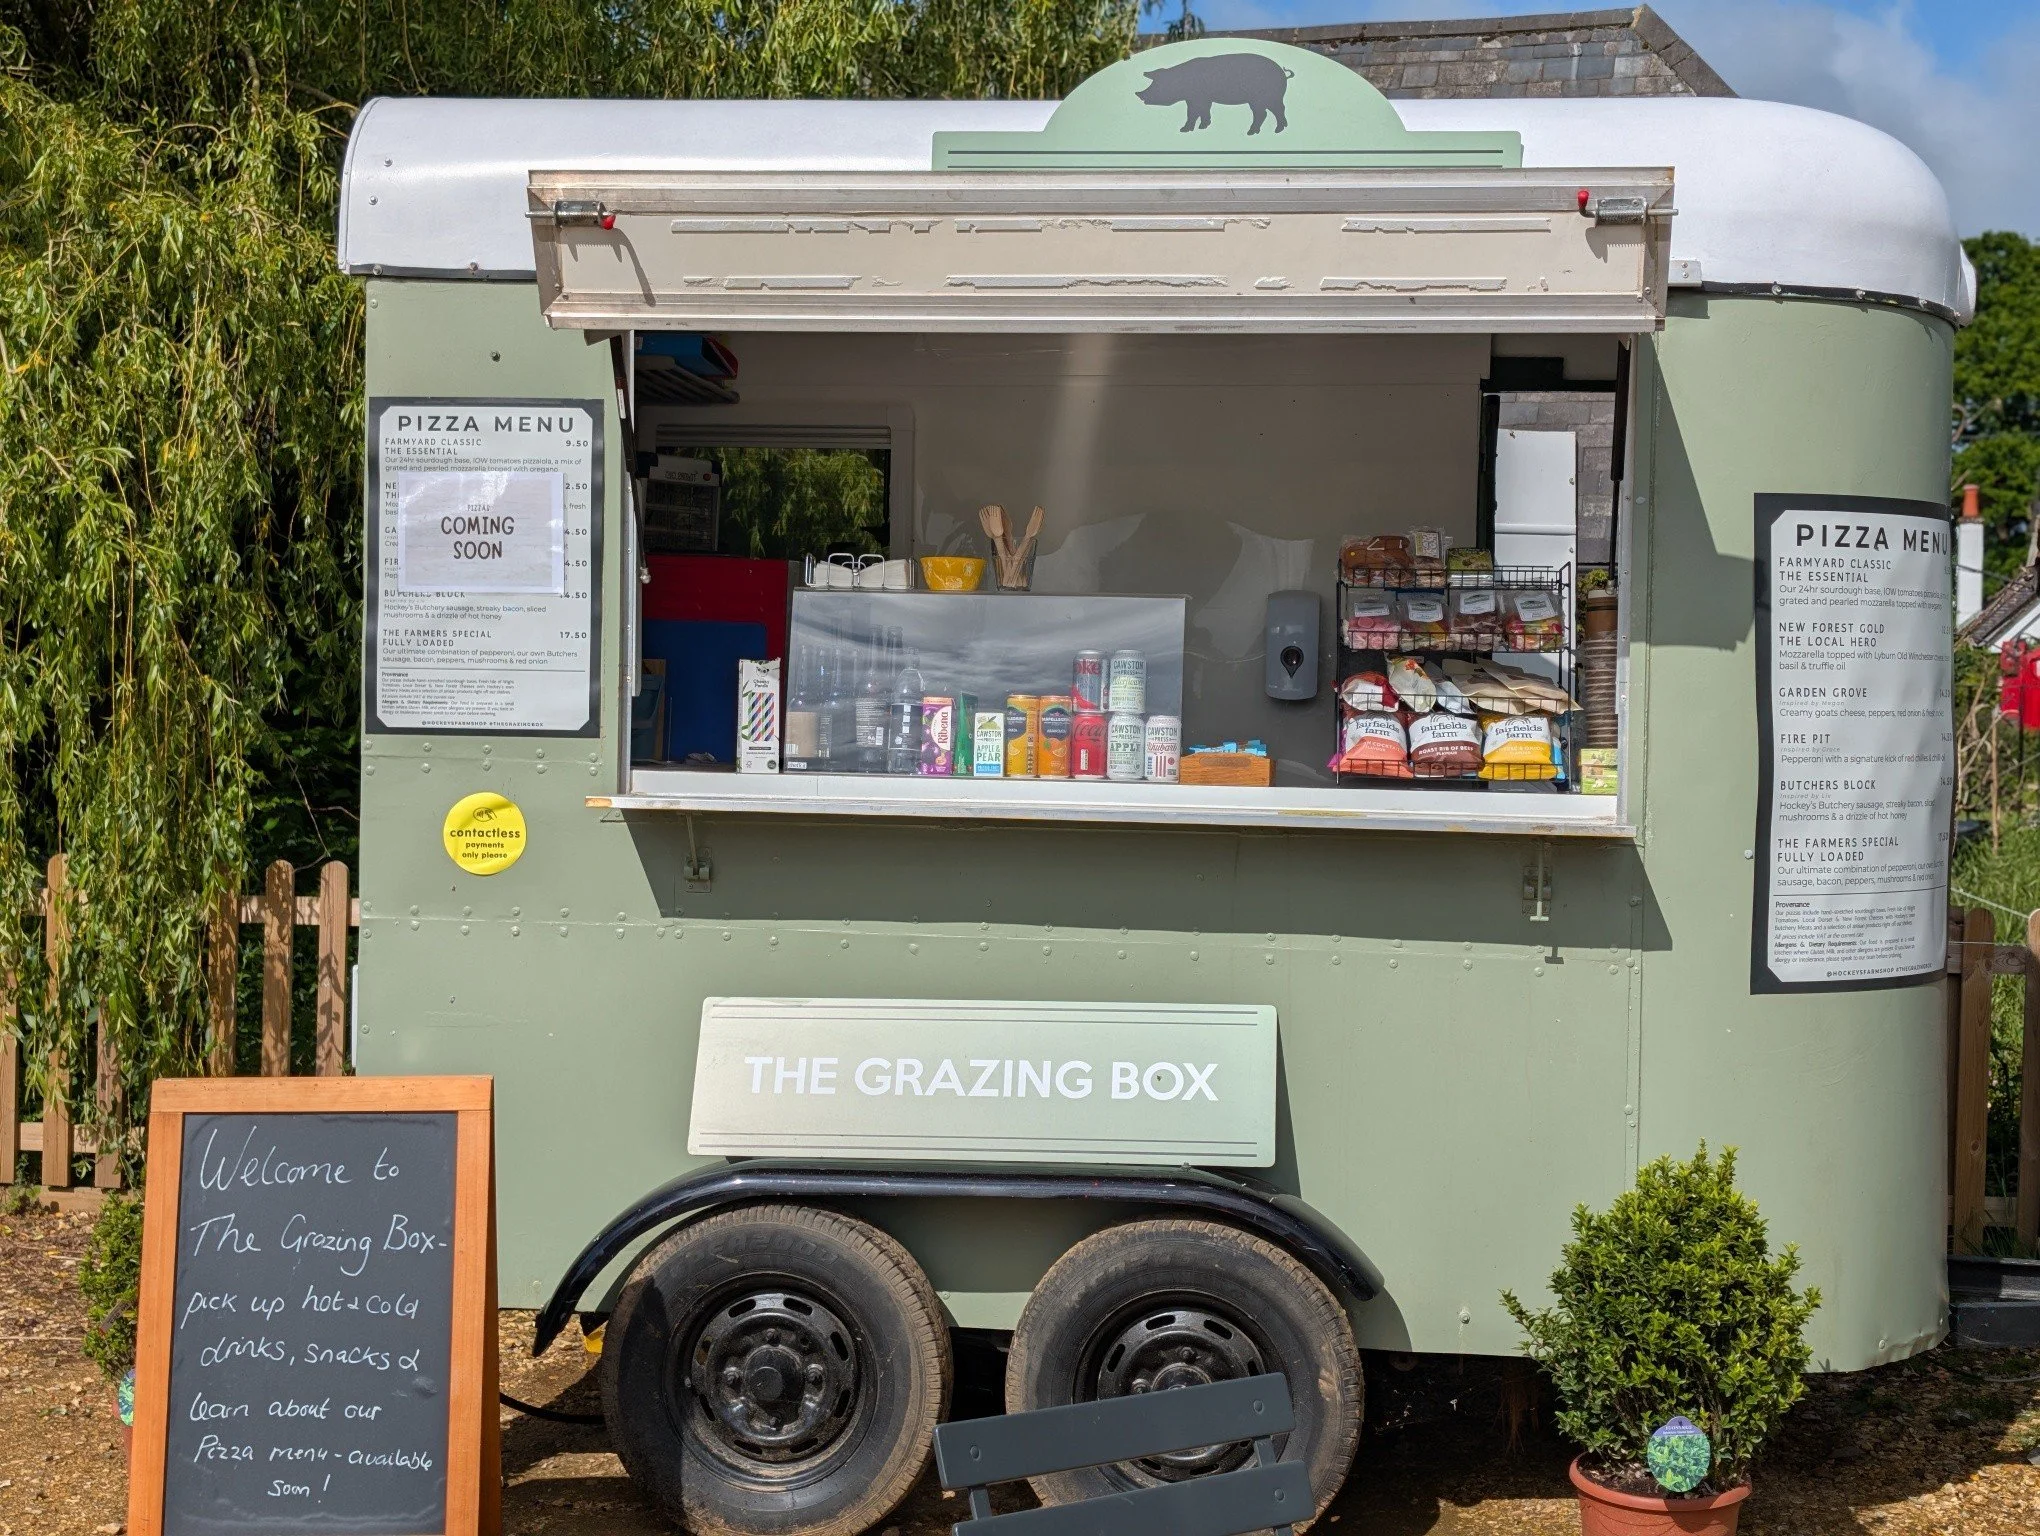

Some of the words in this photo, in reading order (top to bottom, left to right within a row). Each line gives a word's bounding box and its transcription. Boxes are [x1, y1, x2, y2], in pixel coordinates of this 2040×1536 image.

[398, 415, 480, 432] PIZZA
[494, 416, 574, 433] MENU
[385, 437, 436, 446] FARMYARD
[441, 438, 482, 446] CLASSIC
[385, 447, 402, 455] THE
[406, 447, 458, 456] ESSENTIAL
[416, 457, 453, 465] sourdough
[441, 516, 515, 535] COMING
[1796, 524, 1889, 551] PIZZA
[1903, 528, 1948, 556] MENU
[453, 541, 502, 560] SOON
[1779, 557, 1845, 568] FARMYARD
[1850, 559, 1892, 570] CLASSIC
[1779, 571, 1802, 581] THE
[1809, 572, 1869, 583] ESSENTIAL
[1780, 585, 1797, 594] Our
[1799, 585, 1818, 594] 24hr
[1820, 586, 1863, 596] sourdough
[1865, 587, 1882, 596] base,
[1884, 588, 1897, 596] IOW
[1779, 597, 1809, 607] grated
[1811, 597, 1827, 606] and
[1830, 598, 1859, 607] pearled
[1860, 599, 1895, 608] mozzarella
[384, 604, 414, 612] Hockey's
[415, 604, 445, 612] Butchery
[503, 605, 526, 613] bacon,
[1779, 622, 1806, 633] NEW
[1813, 623, 1854, 633] FOREST
[1860, 624, 1885, 634] GOLD
[383, 629, 400, 637] THE
[405, 630, 448, 638] FARMERS
[1779, 636, 1801, 646] THE
[1808, 637, 1844, 647] LOCAL
[1851, 637, 1877, 647] HERO
[428, 648, 470, 656] combination
[1780, 650, 1825, 659] Mozzarella
[1827, 651, 1856, 660] topped
[1857, 651, 1873, 660] with
[1875, 652, 1895, 661] Lyburn
[1114, 660, 1144, 670] CAWSTON
[1780, 661, 1799, 670] basil
[1801, 662, 1807, 670] &
[1809, 662, 1835, 670] truffle
[1836, 662, 1846, 670] oil
[1779, 688, 1826, 698] GARDEN
[1833, 688, 1868, 698] GROVE
[1780, 709, 1813, 718] Creamy
[1815, 709, 1838, 718] goats
[1840, 709, 1867, 718] cheese,
[1869, 710, 1896, 719] peppers,
[938, 712, 949, 744] Ribena
[1112, 725, 1141, 735] CAWSTON
[1148, 727, 1178, 737] CAWSTON
[1356, 720, 1400, 734] fairfields
[1365, 727, 1391, 737] farm
[1421, 722, 1468, 734] fairfields
[1495, 725, 1543, 736] fairfields
[1432, 731, 1457, 739] farm
[1781, 734, 1806, 744] FIRE
[1813, 734, 1831, 744] PIT
[977, 753, 1001, 762] PEAR
[1781, 755, 1824, 765] Pepperoni
[1825, 755, 1842, 763] with
[1850, 755, 1884, 765] signature
[1780, 781, 1839, 790] BUTCHERS
[1844, 780, 1876, 790] BLOCK
[1780, 801, 1817, 811] Hockey's
[1819, 801, 1855, 811] Butchery
[1857, 801, 1885, 811] sausage,
[1780, 814, 1830, 822] mushrooms
[1831, 813, 1838, 821] &
[1846, 813, 1868, 822] drizzle
[1869, 812, 1877, 821] of
[1878, 812, 1889, 820] hot
[1890, 812, 1908, 821] honey
[450, 828, 521, 838] contactless
[466, 842, 505, 850] payments
[1778, 839, 1799, 849] THE
[1805, 838, 1858, 848] FARMERS
[1862, 837, 1899, 847] SPECIAL
[462, 852, 479, 860] only
[482, 852, 508, 860] please
[1778, 852, 1814, 862] FULLY
[1821, 852, 1864, 862] LOADED
[1778, 867, 1794, 875] Our
[1797, 866, 1832, 875] ultimate
[1834, 865, 1880, 874] combination
[1778, 879, 1815, 888] sausage,
[1817, 878, 1843, 886] bacon,
[1845, 878, 1875, 887] peppers,
[1877, 875, 1912, 884] mushrooms
[1827, 968, 1895, 978] @HOCKEYSFARMSHOP
[744, 1056, 839, 1095] THE
[853, 1057, 1093, 1099] GRAZING
[1110, 1061, 1219, 1101] BOX
[199, 1125, 352, 1191] Welcome
[373, 1147, 400, 1181] to
[190, 1213, 262, 1257] The
[280, 1213, 372, 1276] Grazing
[180, 1291, 237, 1330] pick
[251, 1294, 285, 1321] up
[302, 1284, 342, 1313] hot
[200, 1337, 296, 1367] drinks,
[304, 1343, 390, 1370] snacks
[189, 1392, 249, 1422] learn
[268, 1397, 330, 1420] about
[345, 1406, 382, 1421] our
[193, 1434, 253, 1463] Pizza
